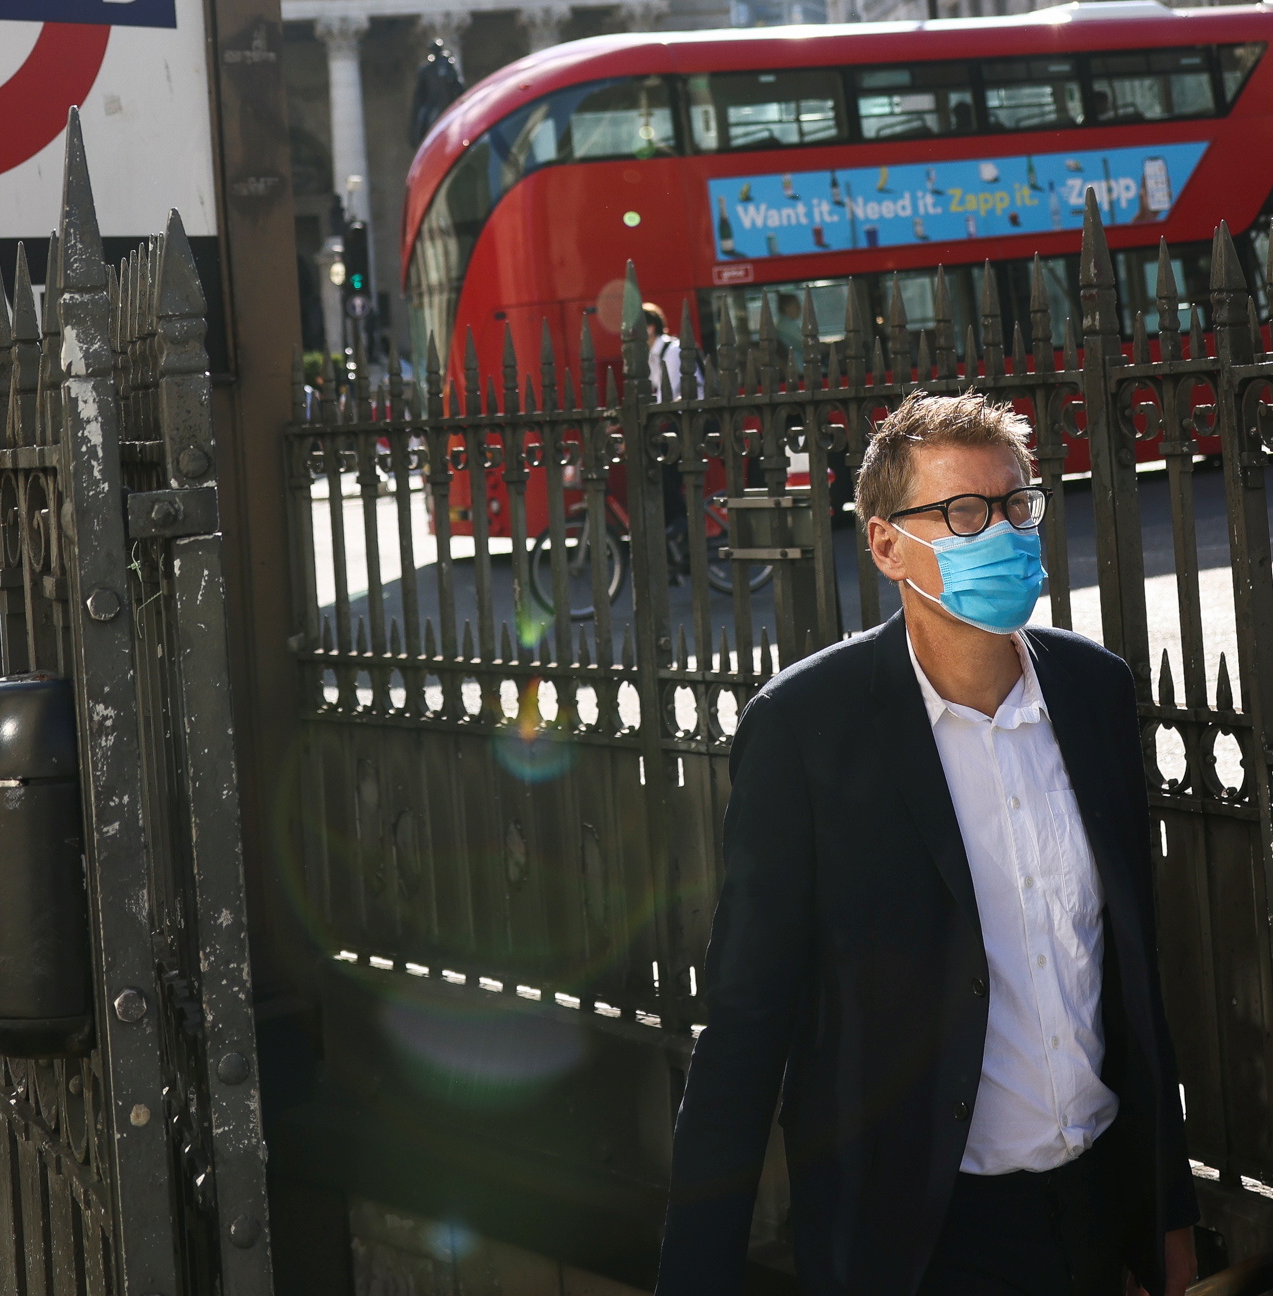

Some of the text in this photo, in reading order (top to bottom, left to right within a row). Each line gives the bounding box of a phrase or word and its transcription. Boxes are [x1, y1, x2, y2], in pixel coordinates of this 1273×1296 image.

[736, 182, 1039, 230] Want it. Need it. Zapp it.
[1064, 176, 1138, 212] Zapp
